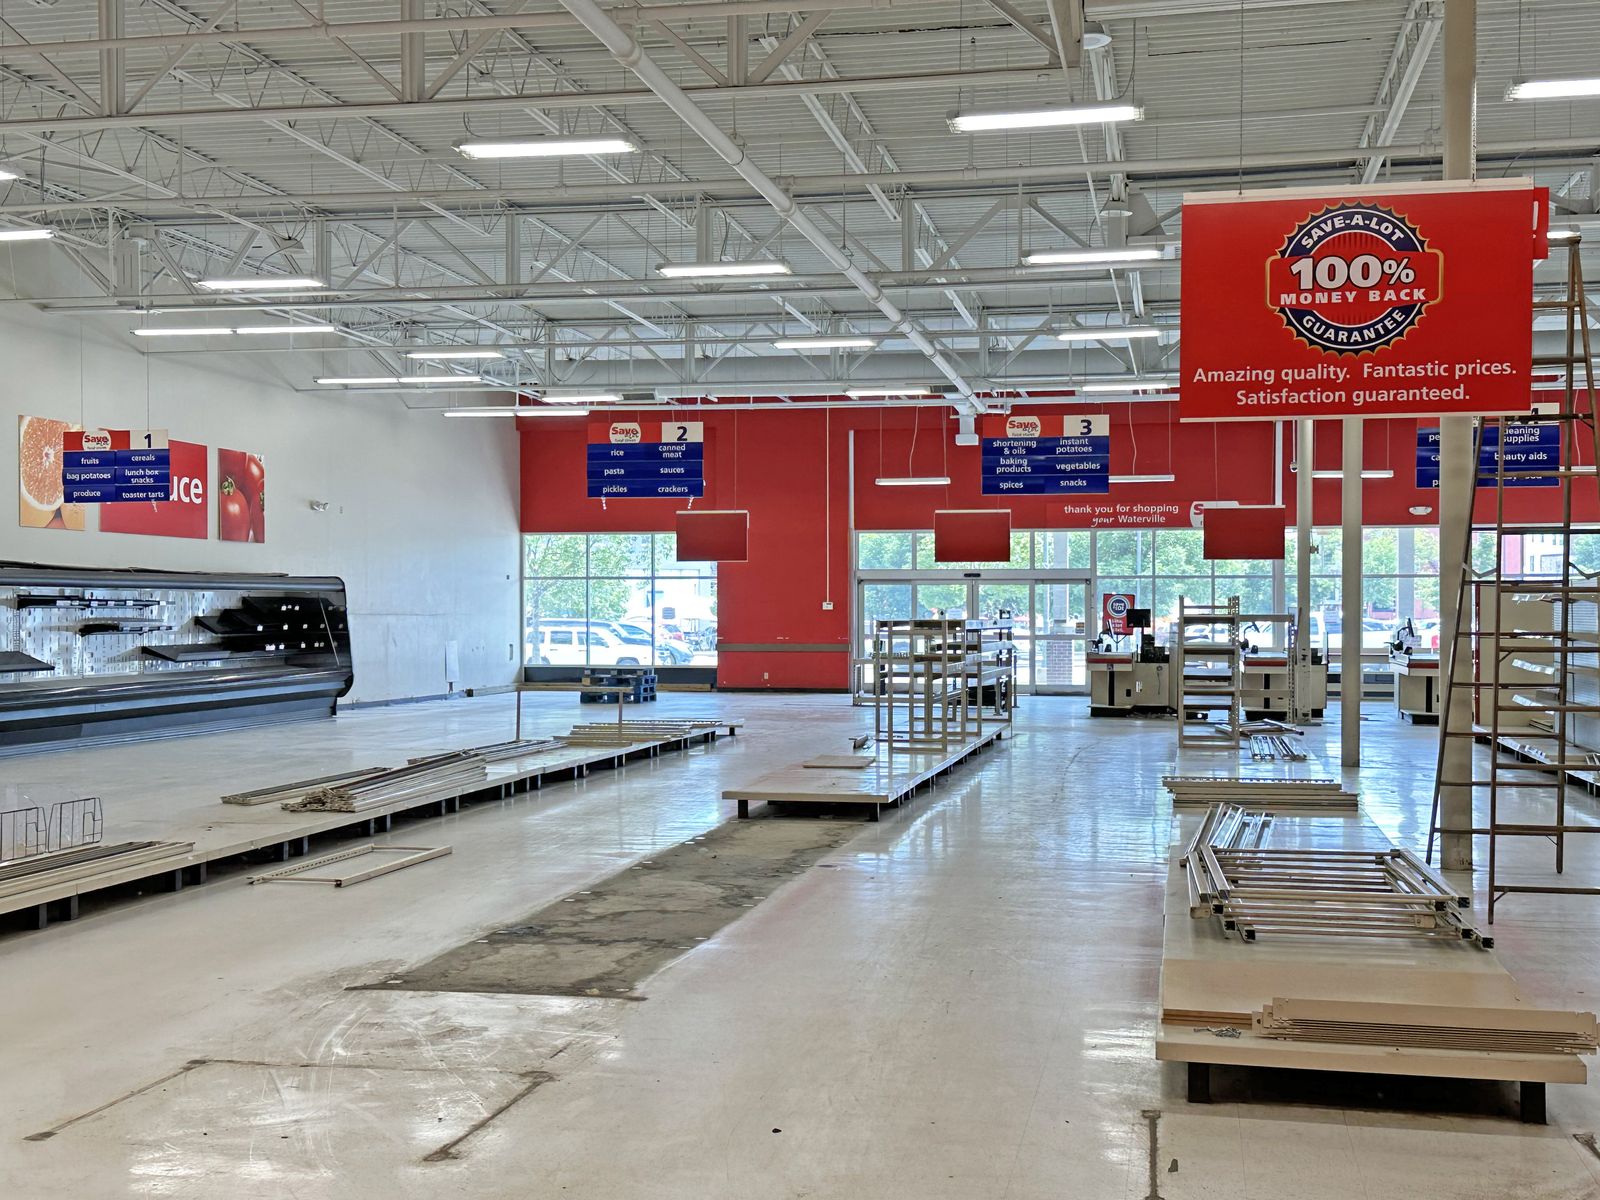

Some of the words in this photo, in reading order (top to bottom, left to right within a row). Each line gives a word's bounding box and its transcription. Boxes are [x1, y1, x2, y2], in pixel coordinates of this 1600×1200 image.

[1301, 214, 1405, 249] SAVE-A-LOT
[1290, 254, 1415, 290] 100%
[1280, 291, 1357, 305] MONEY
[1369, 288, 1426, 302] BACK
[1302, 309, 1406, 343] GUARANTEE
[1193, 366, 1275, 384] Amazing
[1281, 364, 1350, 384] quality.
[1363, 361, 1449, 379] Fantastic
[1455, 360, 1517, 381] prices.
[1236, 387, 1346, 406] Satisfaction
[1352, 384, 1470, 407] guaranteed.
[1008, 420, 1038, 430] Save
[1080, 419, 1092, 436] 3
[611, 426, 639, 436] Save
[676, 426, 688, 442] 2
[144, 433, 152, 449] 1
[993, 440, 1037, 449] shortening
[1059, 438, 1088, 446] instant
[610, 449, 625, 457] rice
[1012, 447, 1026, 455] oils
[1056, 445, 1092, 454] potatoes
[131, 453, 156, 462] cereals
[1528, 451, 1548, 460] aids
[81, 456, 99, 465] fruits
[1000, 457, 1028, 466] baking
[660, 466, 685, 474] sauces
[996, 465, 1032, 474] products
[1056, 462, 1101, 471] vegetables
[66, 472, 80, 481] bag
[81, 471, 111, 481] potatoes
[125, 468, 144, 477] lunch
[145, 468, 159, 476] box
[604, 467, 624, 476] pasta
[131, 476, 154, 484] snacks
[1060, 479, 1087, 487] snacks
[602, 485, 628, 494] pickles
[657, 485, 689, 493] crackers
[999, 481, 1024, 490] spices
[73, 489, 101, 499] produce
[122, 490, 147, 499] toaster
[148, 490, 165, 498] tarts
[1064, 504, 1092, 514] thank
[1094, 506, 1113, 515] you
[1116, 503, 1131, 513] for
[1132, 503, 1179, 514] shopping
[1090, 516, 1115, 528] your
[1117, 514, 1166, 523] Waterville
